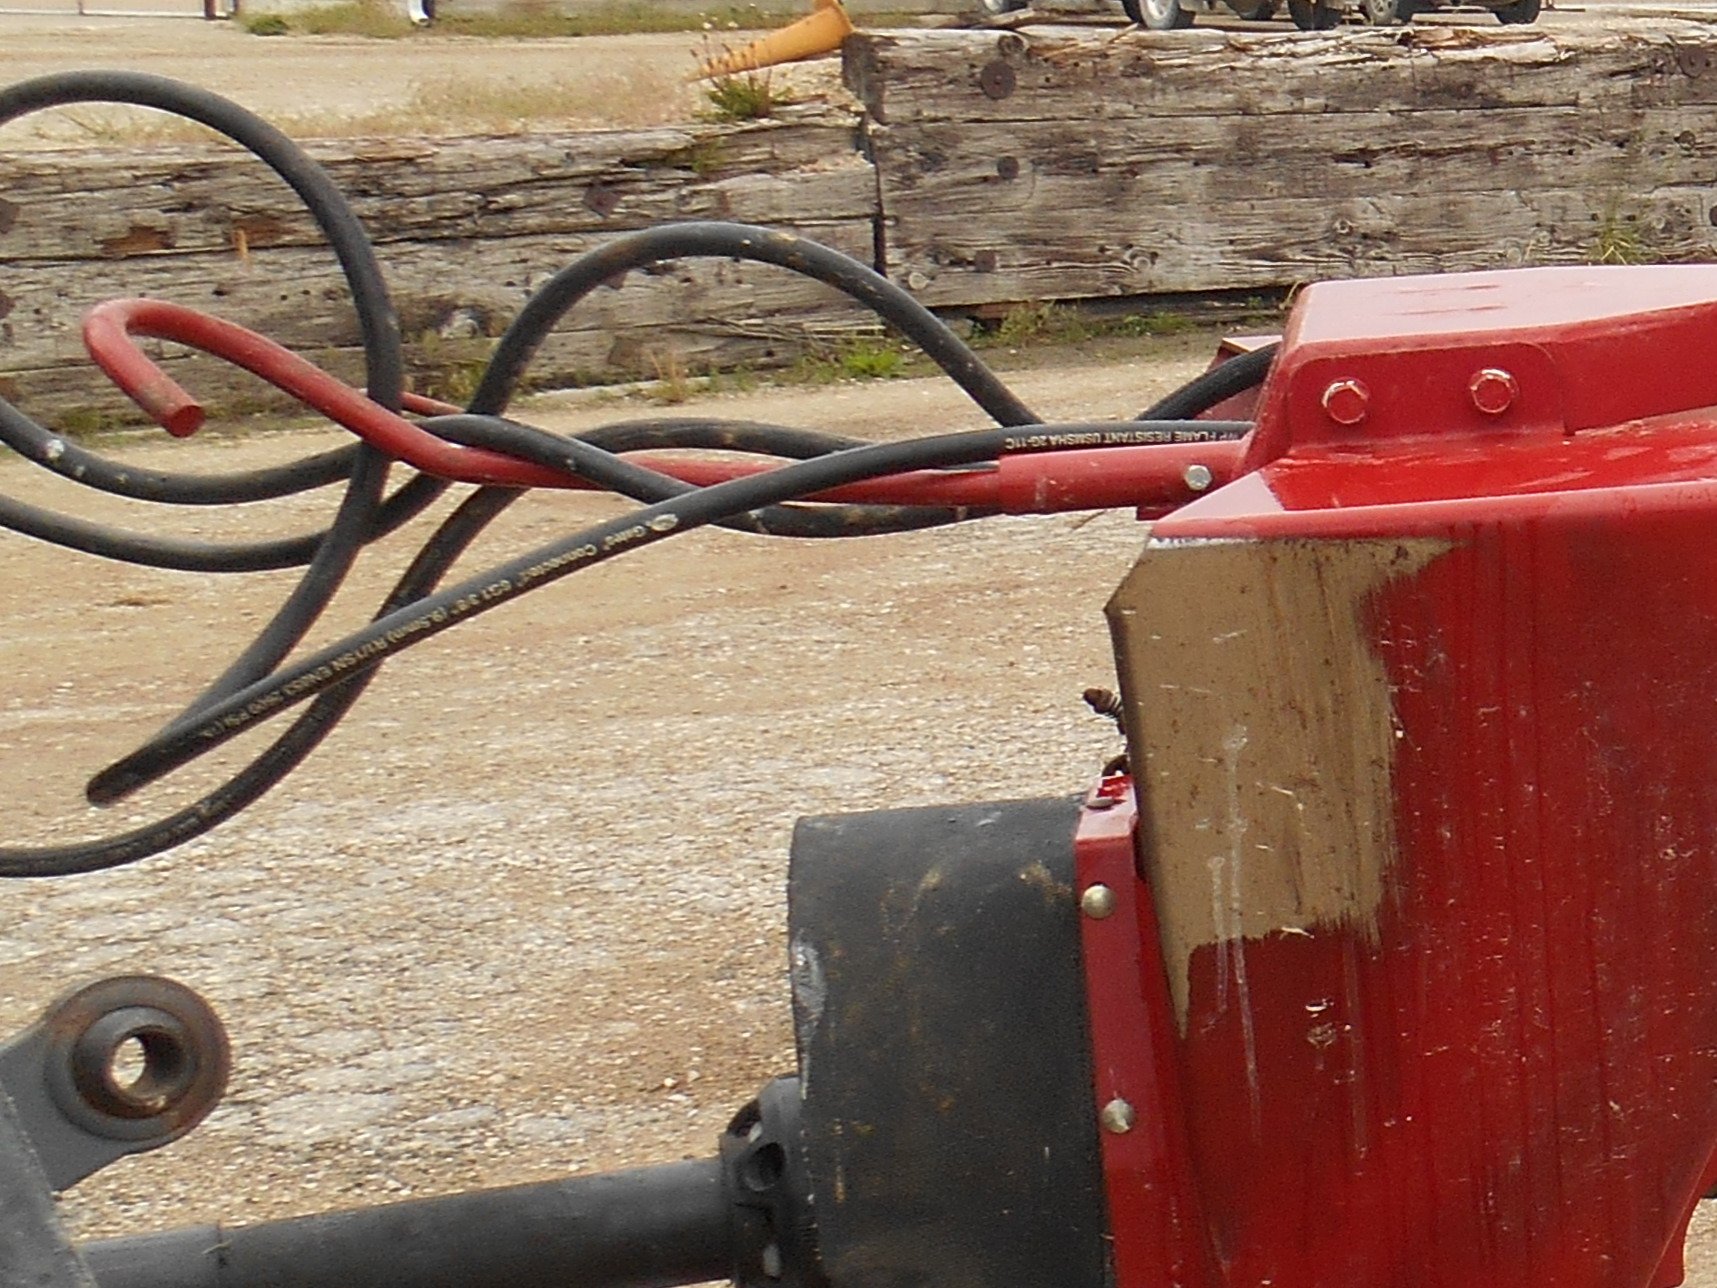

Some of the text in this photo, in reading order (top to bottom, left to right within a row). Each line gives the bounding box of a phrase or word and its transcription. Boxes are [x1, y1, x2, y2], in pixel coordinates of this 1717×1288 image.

[1103, 431, 1172, 443] RESISTANT
[1174, 431, 1217, 442] FLAME
[1004, 436, 1050, 450] 2G-11C
